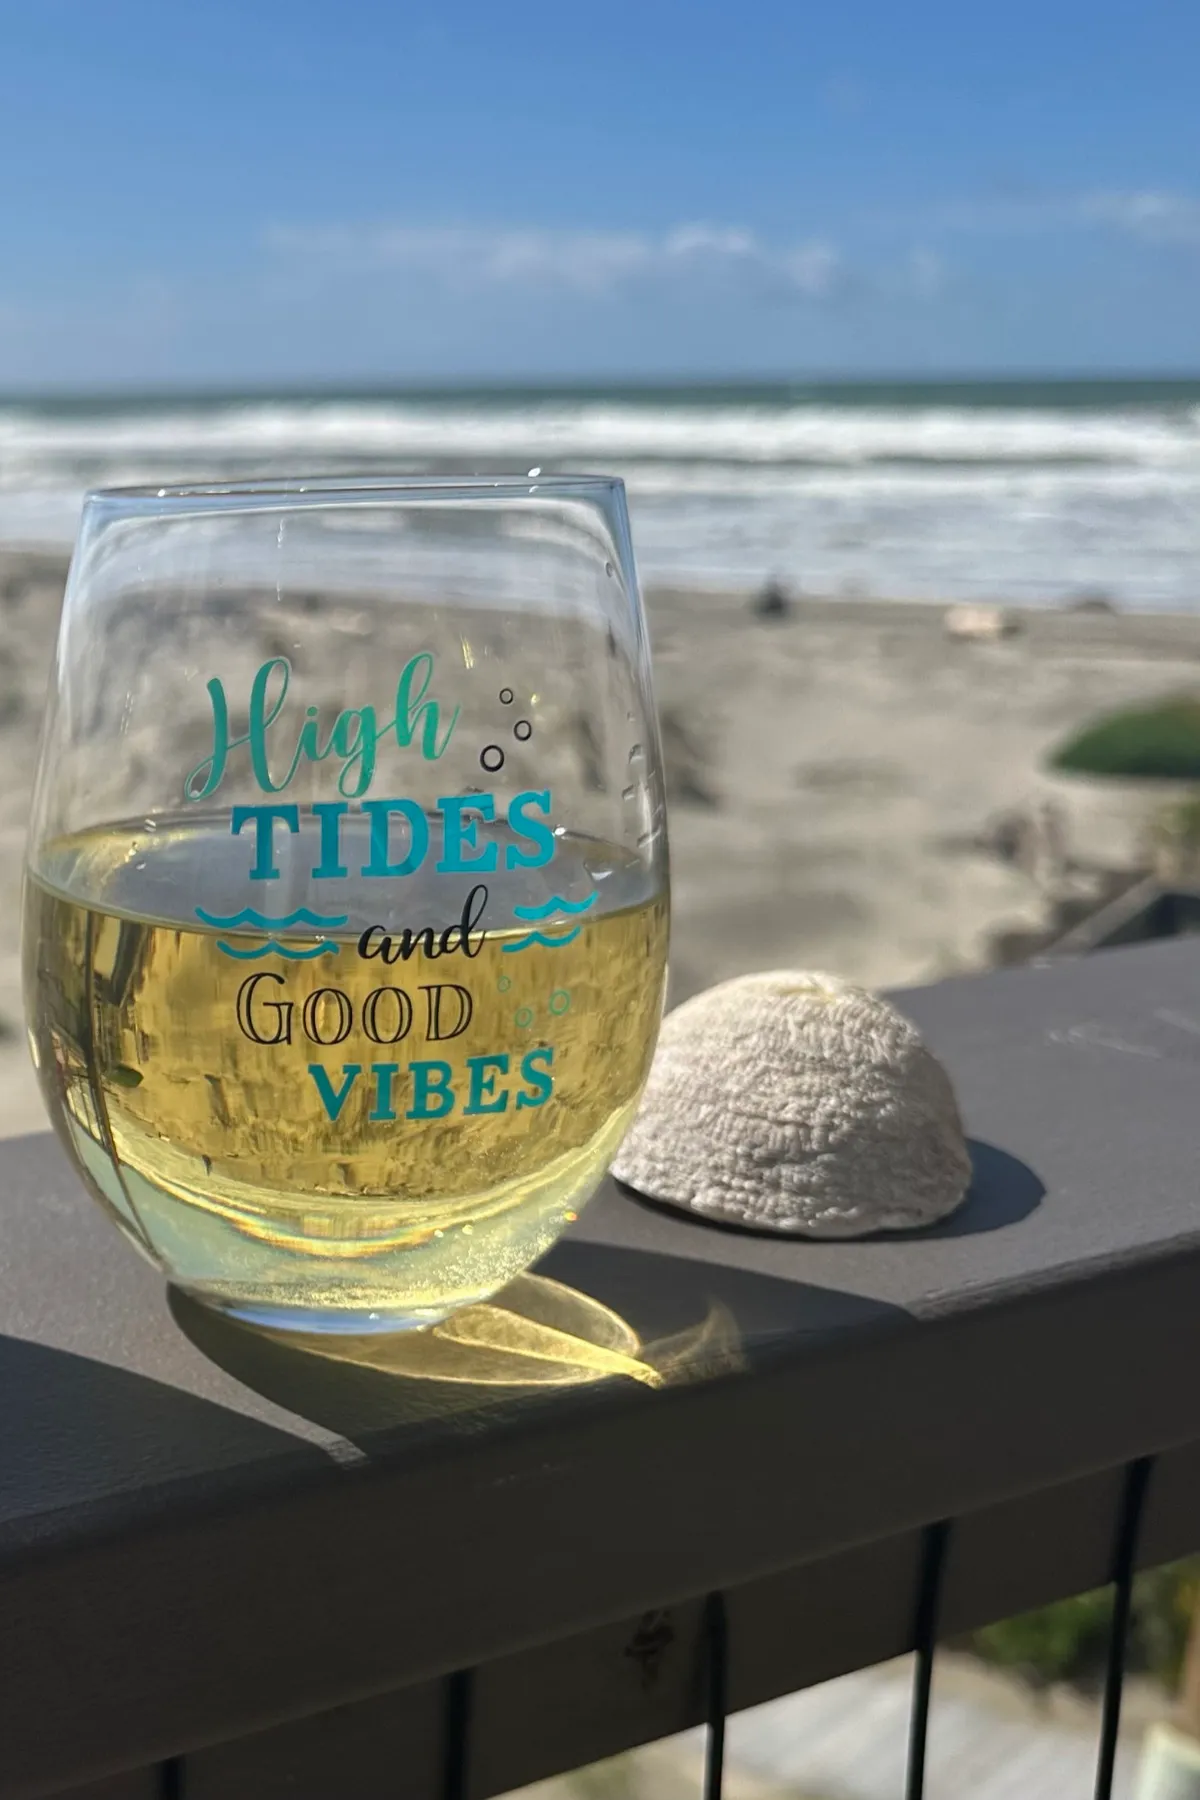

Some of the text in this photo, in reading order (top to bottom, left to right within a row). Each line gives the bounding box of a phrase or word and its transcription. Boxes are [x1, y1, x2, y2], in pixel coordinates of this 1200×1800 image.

[184, 653, 461, 800] High
[231, 790, 556, 880] TIDES
[357, 885, 489, 965] and
[236, 972, 473, 1046] GOOD
[308, 1048, 556, 1122] VIBES
